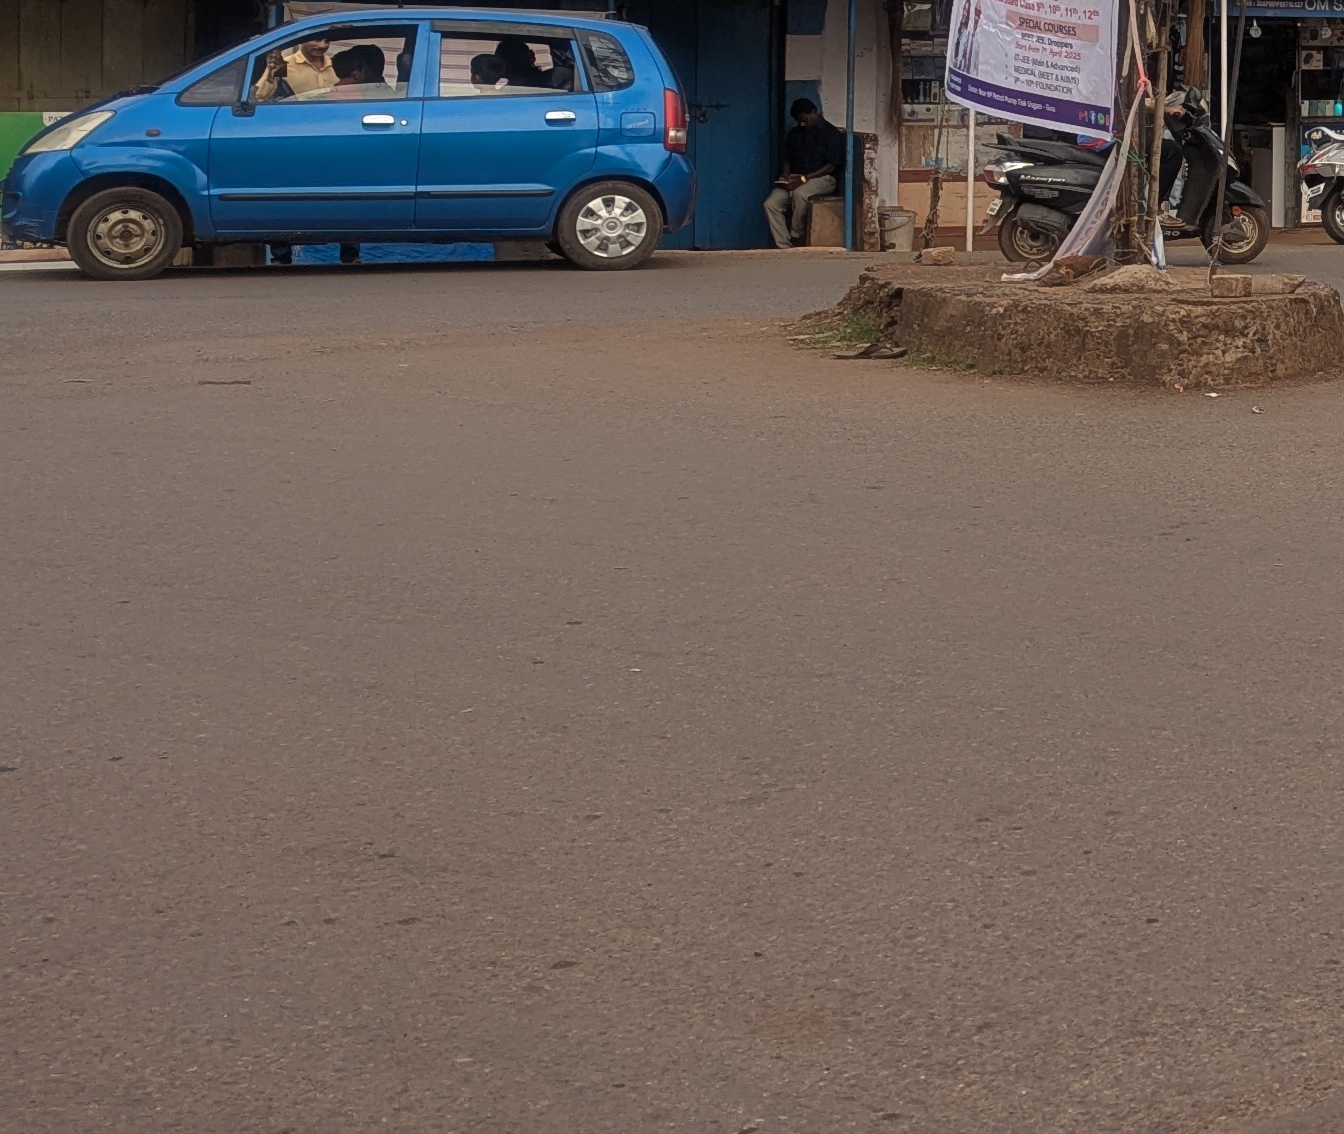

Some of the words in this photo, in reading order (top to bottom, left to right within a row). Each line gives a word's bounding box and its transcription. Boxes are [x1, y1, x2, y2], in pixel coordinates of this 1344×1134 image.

[1018, 17, 1042, 31] SPECIAL
[1043, 22, 1077, 36] COURSES
[1064, 51, 1081, 61] 2025
